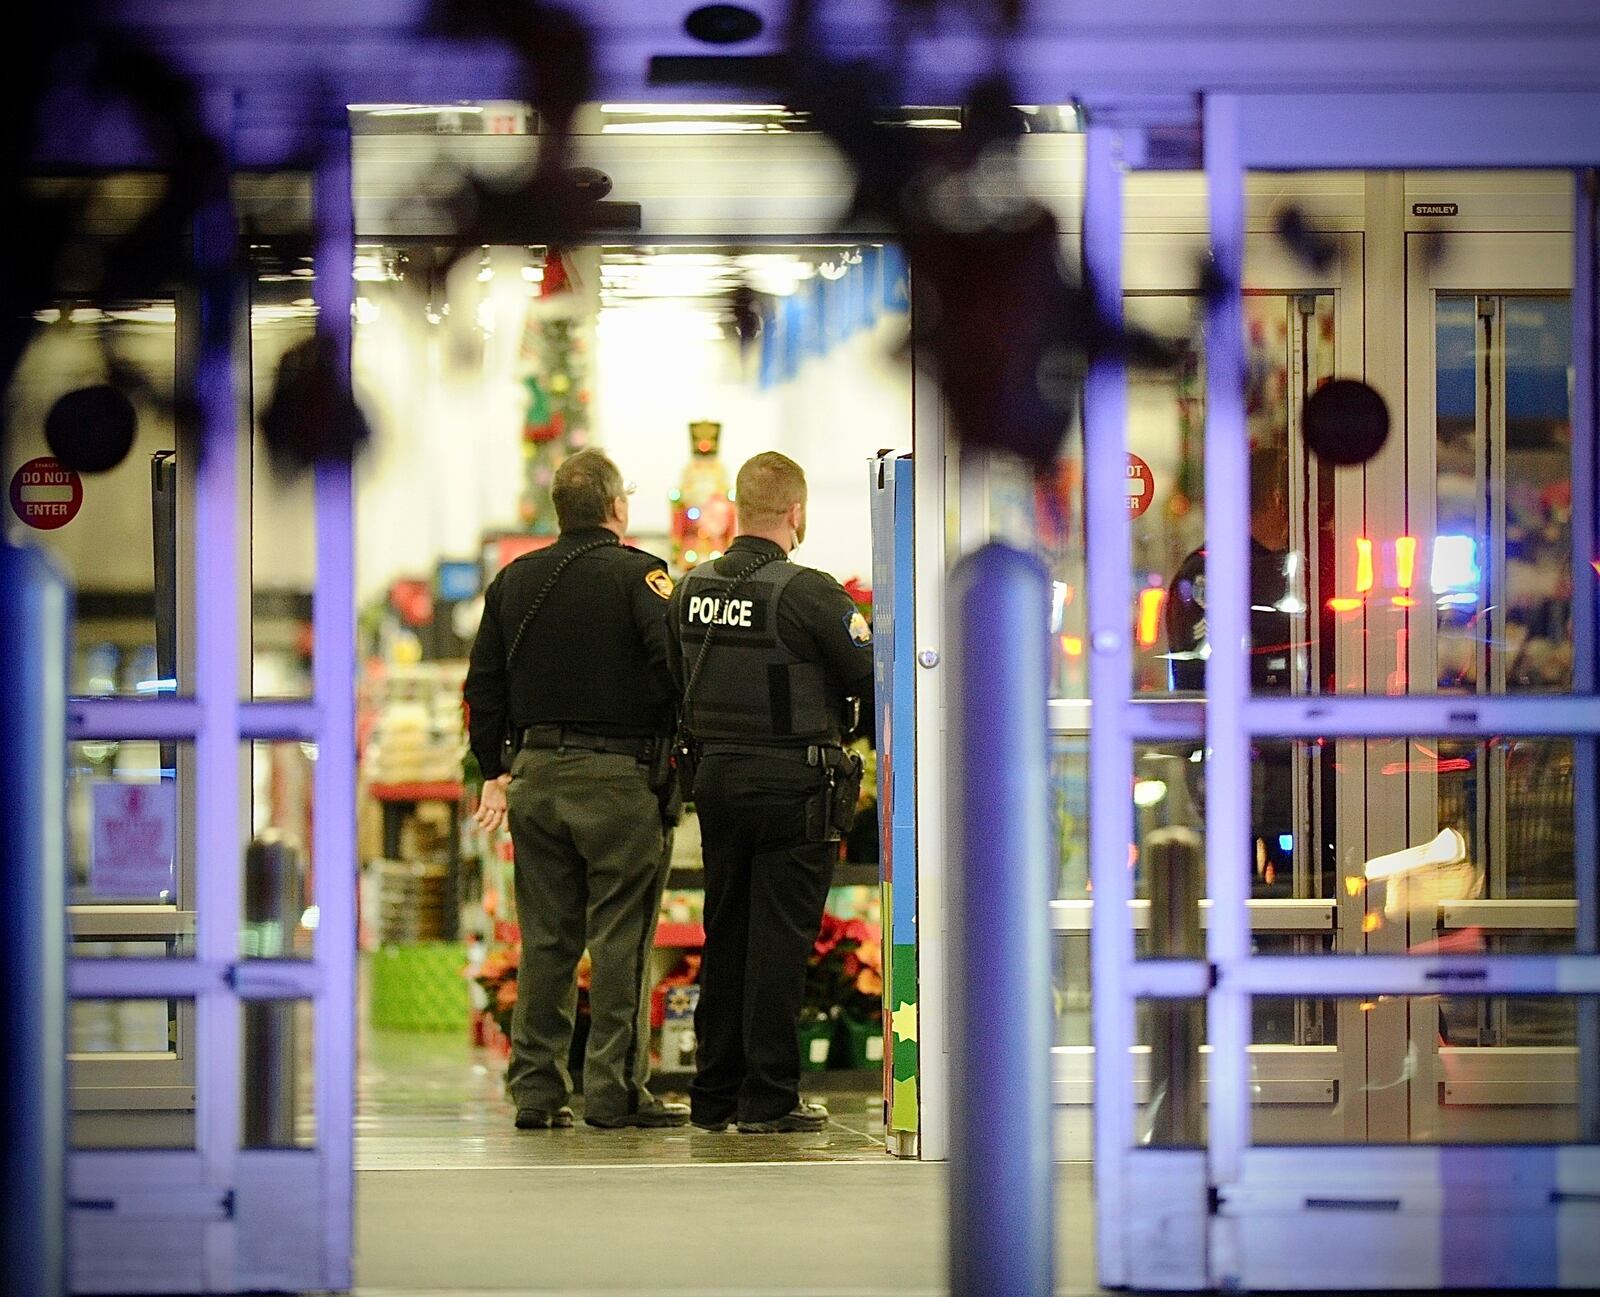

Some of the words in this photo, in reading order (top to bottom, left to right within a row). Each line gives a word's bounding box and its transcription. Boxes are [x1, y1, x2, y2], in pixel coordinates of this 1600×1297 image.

[1416, 206, 1455, 214] STANLEY
[1126, 465, 1143, 477] OT
[22, 472, 41, 483] DO
[44, 472, 72, 483] NOT
[26, 504, 68, 516] ENTER
[688, 596, 753, 627] POLICE
